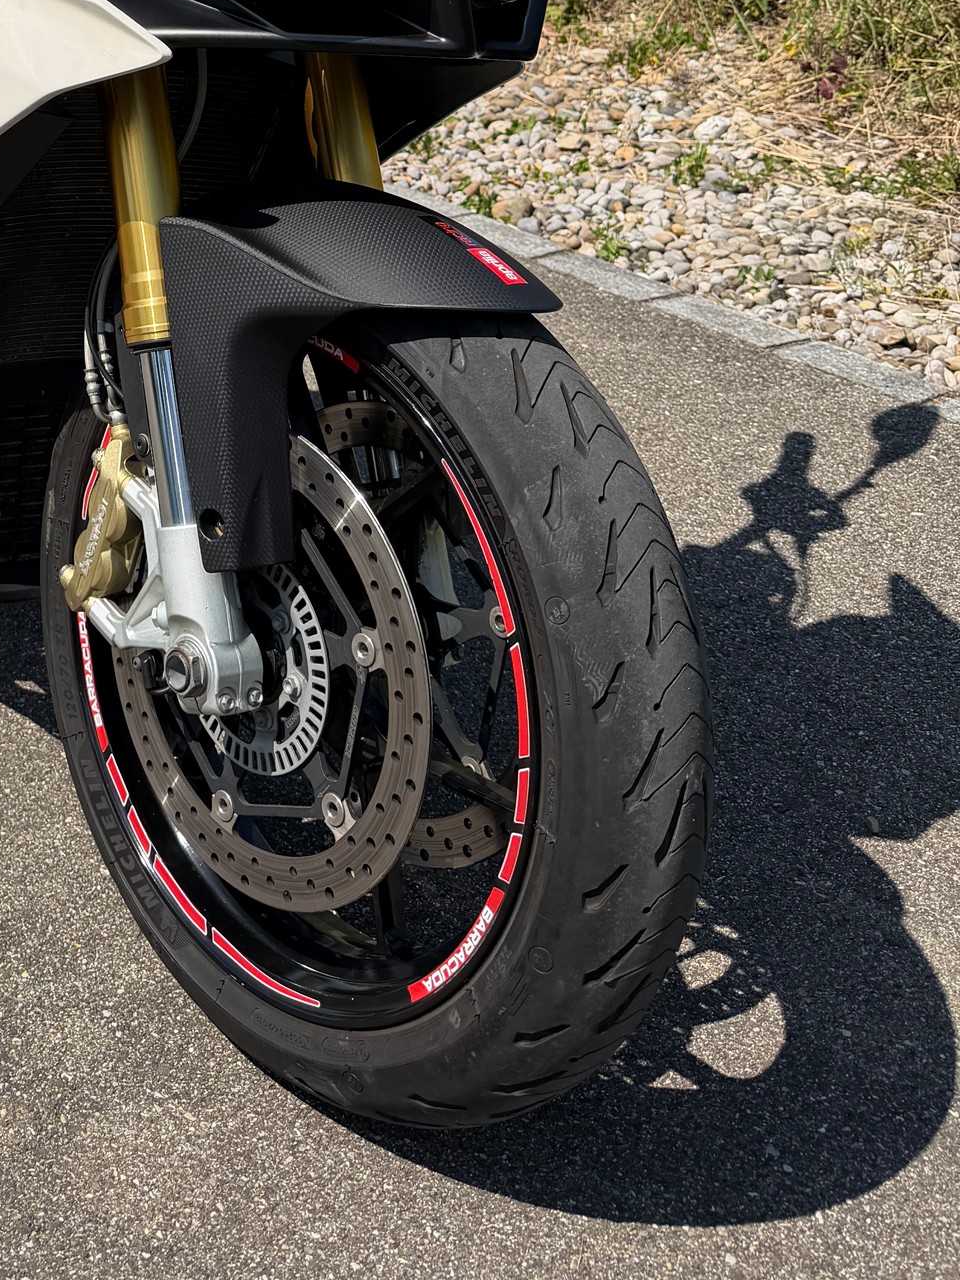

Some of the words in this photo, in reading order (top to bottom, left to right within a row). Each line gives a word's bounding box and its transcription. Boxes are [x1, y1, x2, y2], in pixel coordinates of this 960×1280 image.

[479, 250, 518, 280] aprilia
[387, 356, 503, 522] MICHELIN
[58, 654, 78, 721] 120/70
[77, 611, 103, 727] BARRACUDA
[80, 758, 160, 909] MICHELIN
[422, 905, 494, 992] BARRACUDA
